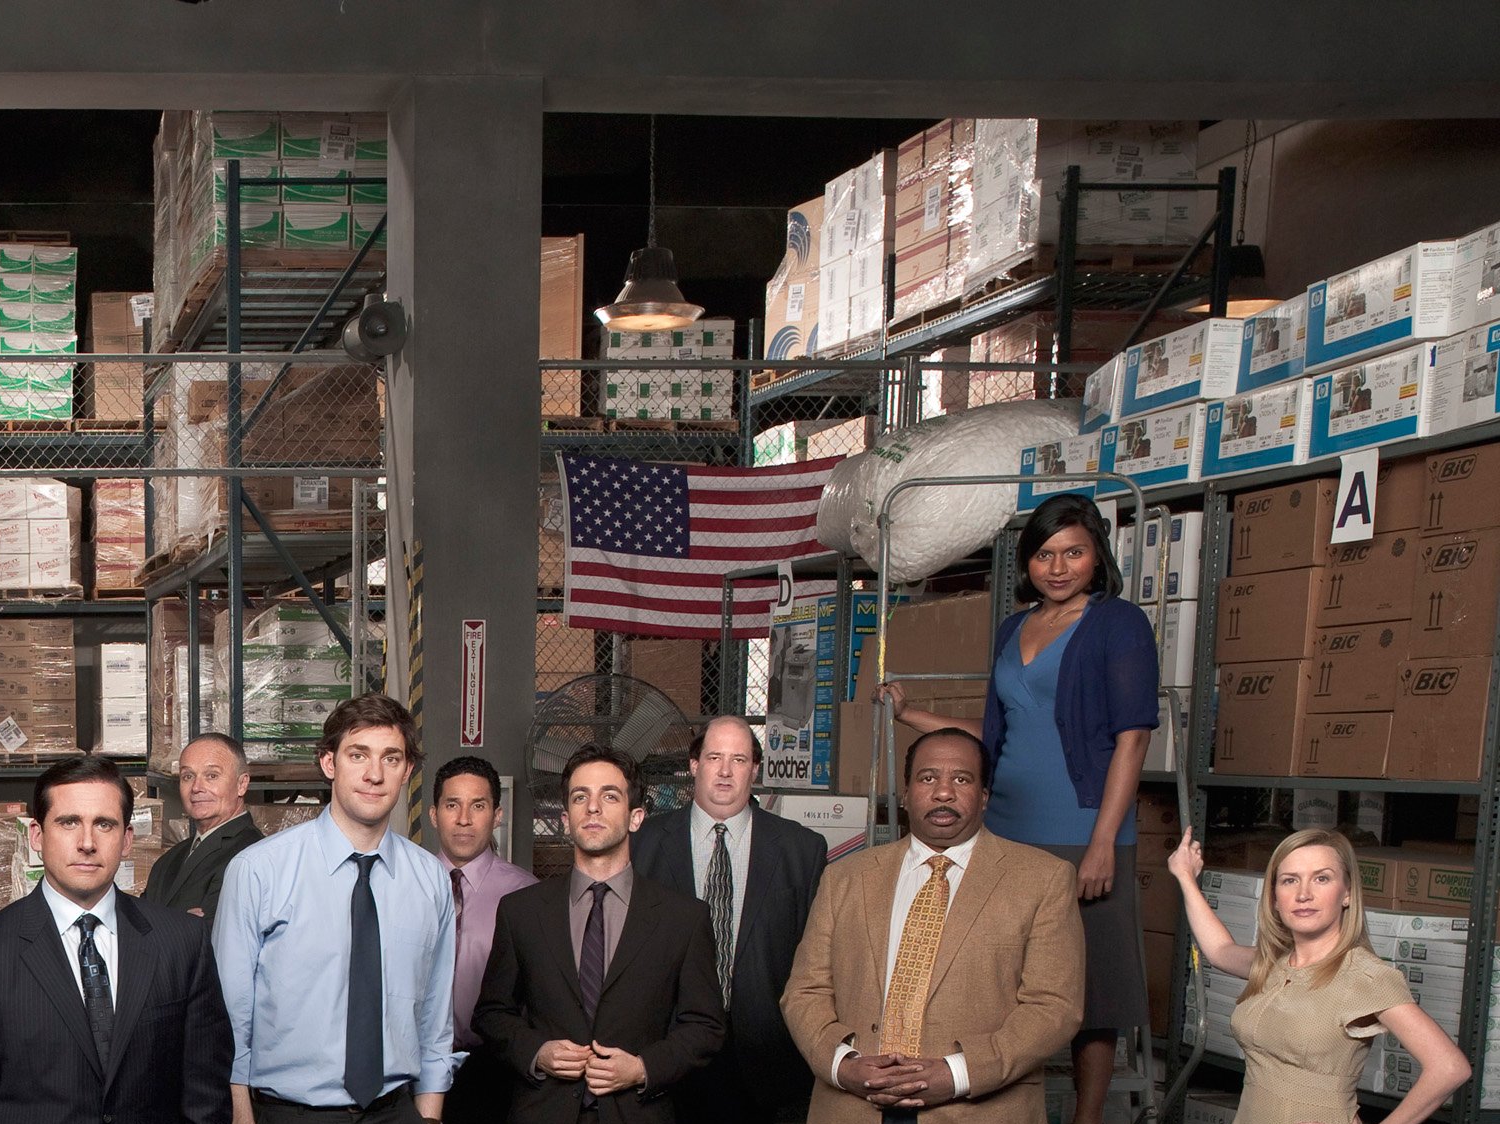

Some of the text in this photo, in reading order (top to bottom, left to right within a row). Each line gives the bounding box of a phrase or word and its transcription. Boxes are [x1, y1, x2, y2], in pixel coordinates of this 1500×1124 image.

[1336, 470, 1371, 528] A
[777, 574, 792, 608] D
[466, 631, 482, 640] FIRE
[767, 756, 811, 779] brother
